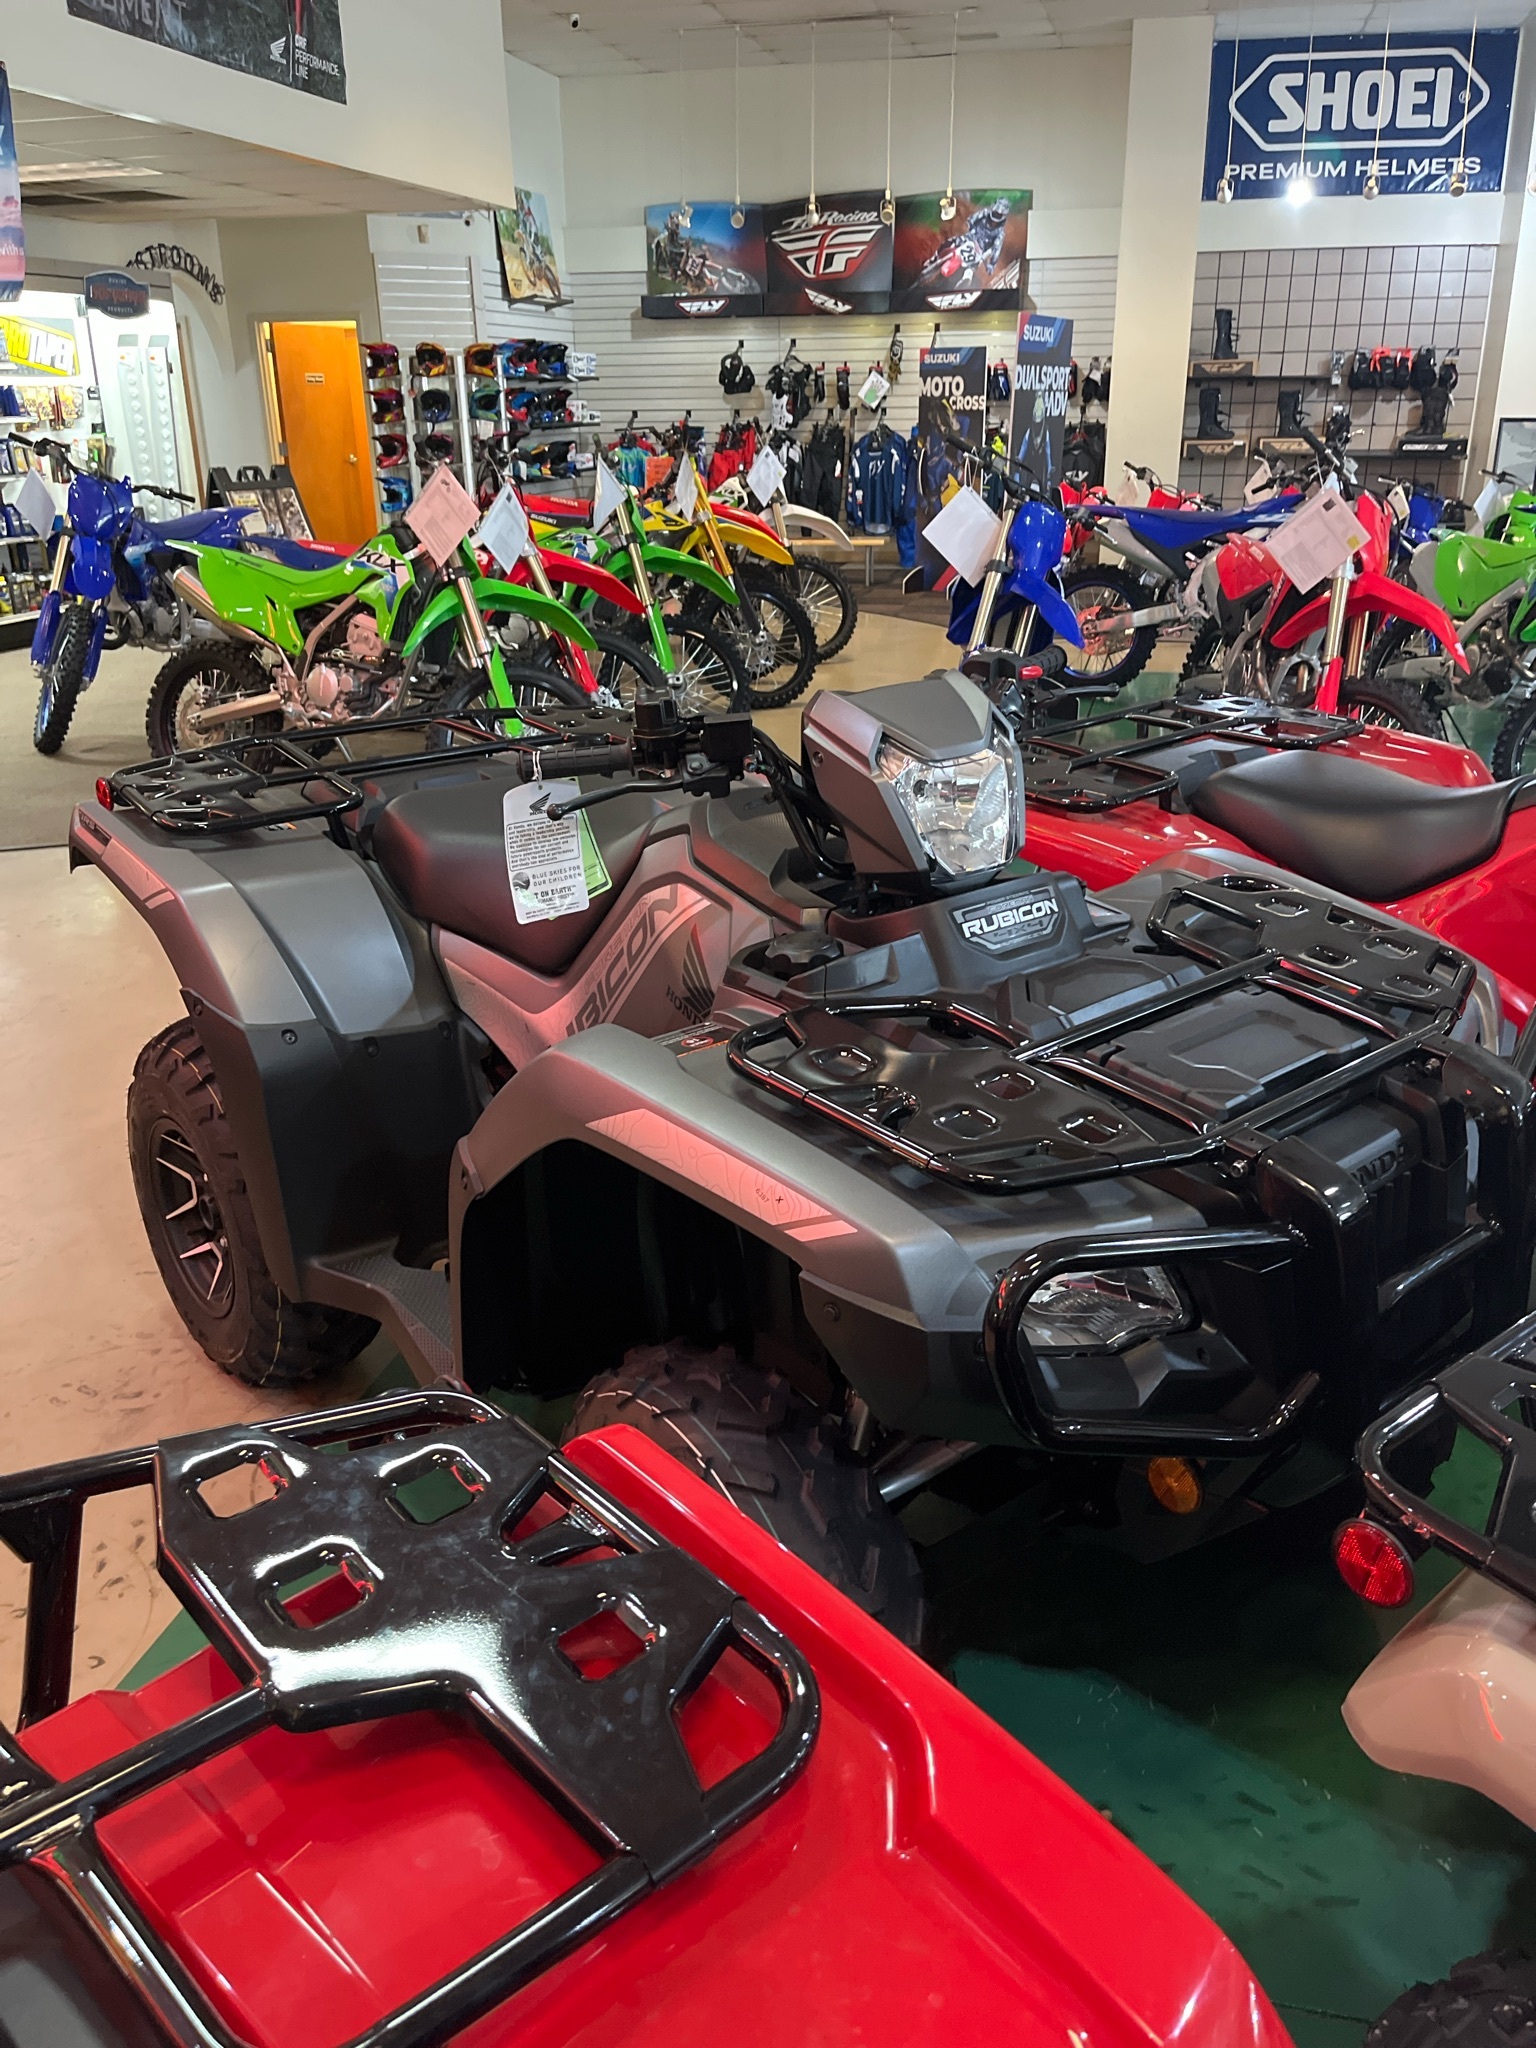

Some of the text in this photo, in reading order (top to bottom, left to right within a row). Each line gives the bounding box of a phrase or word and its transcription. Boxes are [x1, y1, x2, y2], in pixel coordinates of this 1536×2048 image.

[295, 49, 339, 76] PERFORMANCE
[295, 63, 308, 80] LINE
[1267, 67, 1454, 133] SHOEI
[1227, 156, 1481, 181] PREMIUM HELMETS
[820, 210, 879, 226] Racing
[961, 245, 976, 264] 29
[1023, 324, 1055, 342] SUZUKI
[924, 353, 960, 364] SUZUKI
[919, 376, 964, 397] MOTO
[1015, 364, 1071, 391] DUALSPORT
[950, 395, 984, 411] CROSS
[551, 496, 579, 507] HONDA
[530, 513, 557, 525] SUZUKI
[310, 543, 335, 552] HONDA
[356, 549, 406, 573] KLX
[548, 872, 582, 883] CHILDREN
[549, 867, 568, 876] SKIES
[962, 898, 1058, 938] RUBICON
[566, 884, 678, 1038] BICON
[666, 984, 701, 1025] HOND
